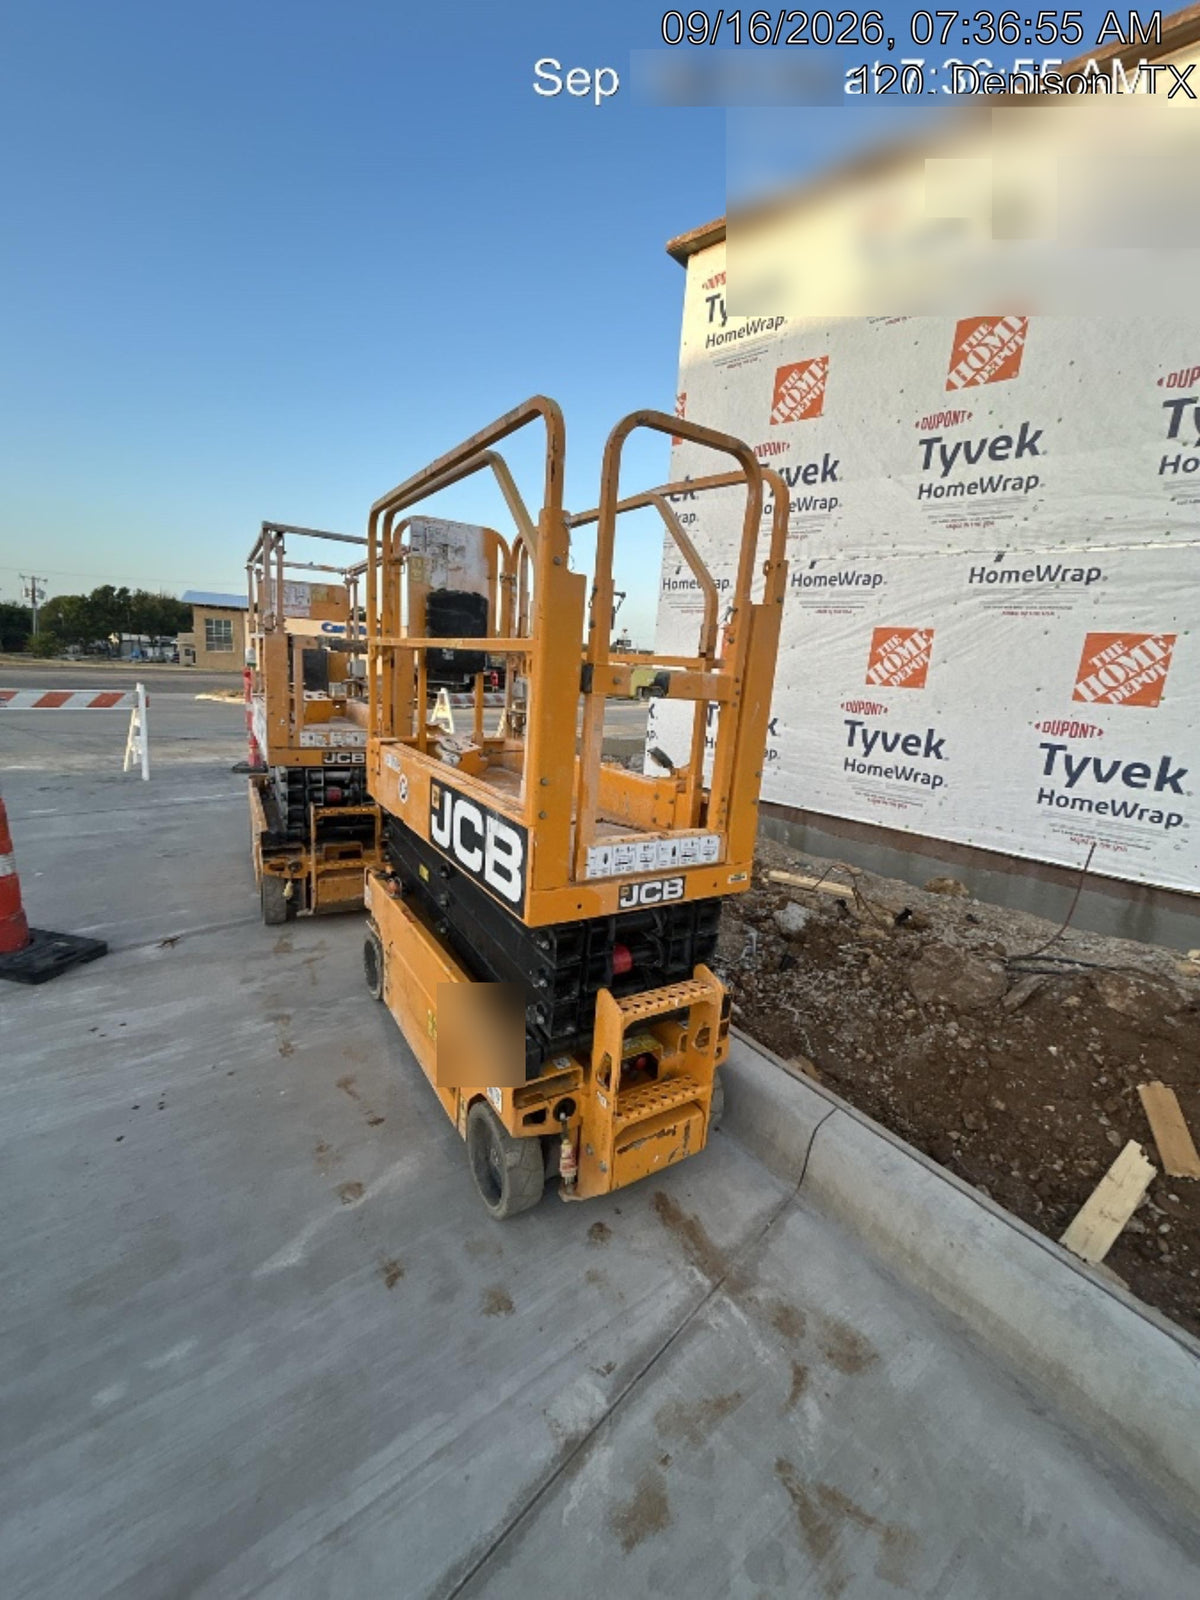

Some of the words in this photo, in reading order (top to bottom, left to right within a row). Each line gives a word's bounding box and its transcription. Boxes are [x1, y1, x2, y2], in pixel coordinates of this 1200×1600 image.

[705, 316, 785, 349] HomeWrap
[959, 322, 993, 353] THE
[973, 332, 1025, 384] DEPOT
[772, 358, 828, 423] HOME
[779, 369, 801, 397] THE
[790, 379, 825, 421] DEPOT
[921, 410, 967, 430] DUPONT
[919, 421, 1043, 478] Tyvek
[918, 474, 1040, 500] HomeWrap
[764, 496, 838, 515] oeWrap
[791, 571, 883, 589] HomeWrap
[968, 564, 1102, 586] HomeWrap
[868, 629, 933, 684] HOME
[876, 634, 903, 657] THE
[1088, 640, 1128, 668] THE
[888, 650, 930, 686] DEPOT
[1075, 635, 1173, 702] HOME
[1106, 661, 1167, 704] DEPOT
[846, 700, 884, 715] DUPONT
[844, 719, 946, 759] Tyvek
[1042, 720, 1097, 738] DUPONT
[324, 752, 365, 764] JCB
[844, 757, 944, 790] HomeWrap
[1039, 742, 1188, 795] Tyvek
[1037, 787, 1183, 830] HomeWrap
[431, 791, 523, 903] JCB
[620, 877, 684, 908] JCB
